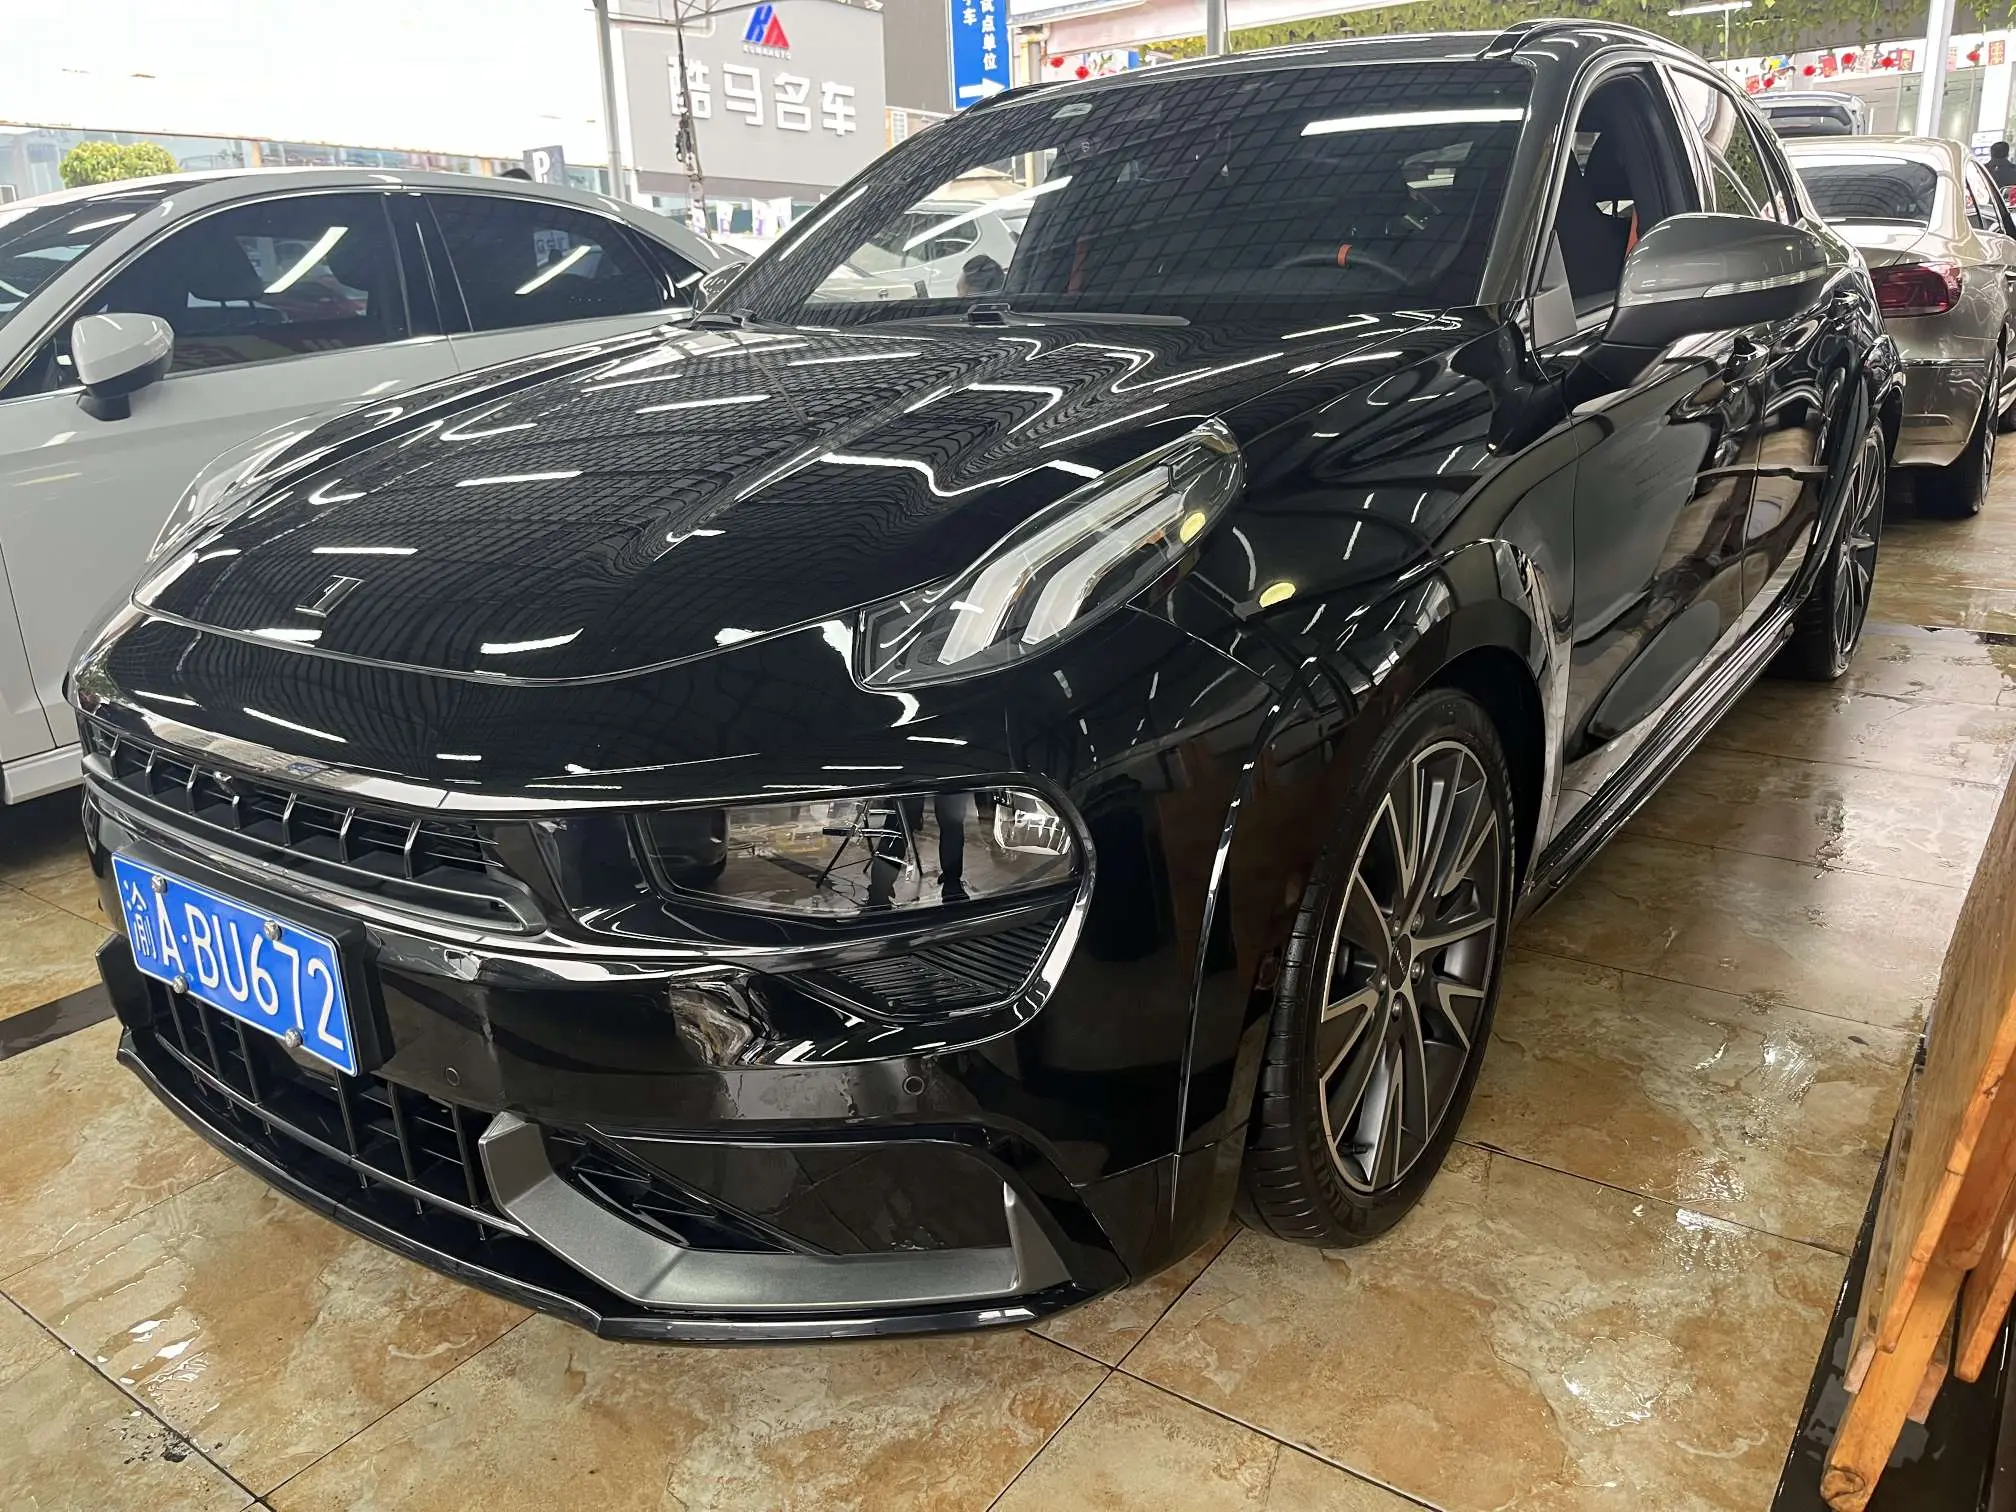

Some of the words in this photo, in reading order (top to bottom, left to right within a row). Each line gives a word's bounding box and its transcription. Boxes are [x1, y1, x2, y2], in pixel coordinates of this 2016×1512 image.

[668, 56, 857, 136] 酷马名车
[123, 880, 344, 1050] 渝A·BU672
